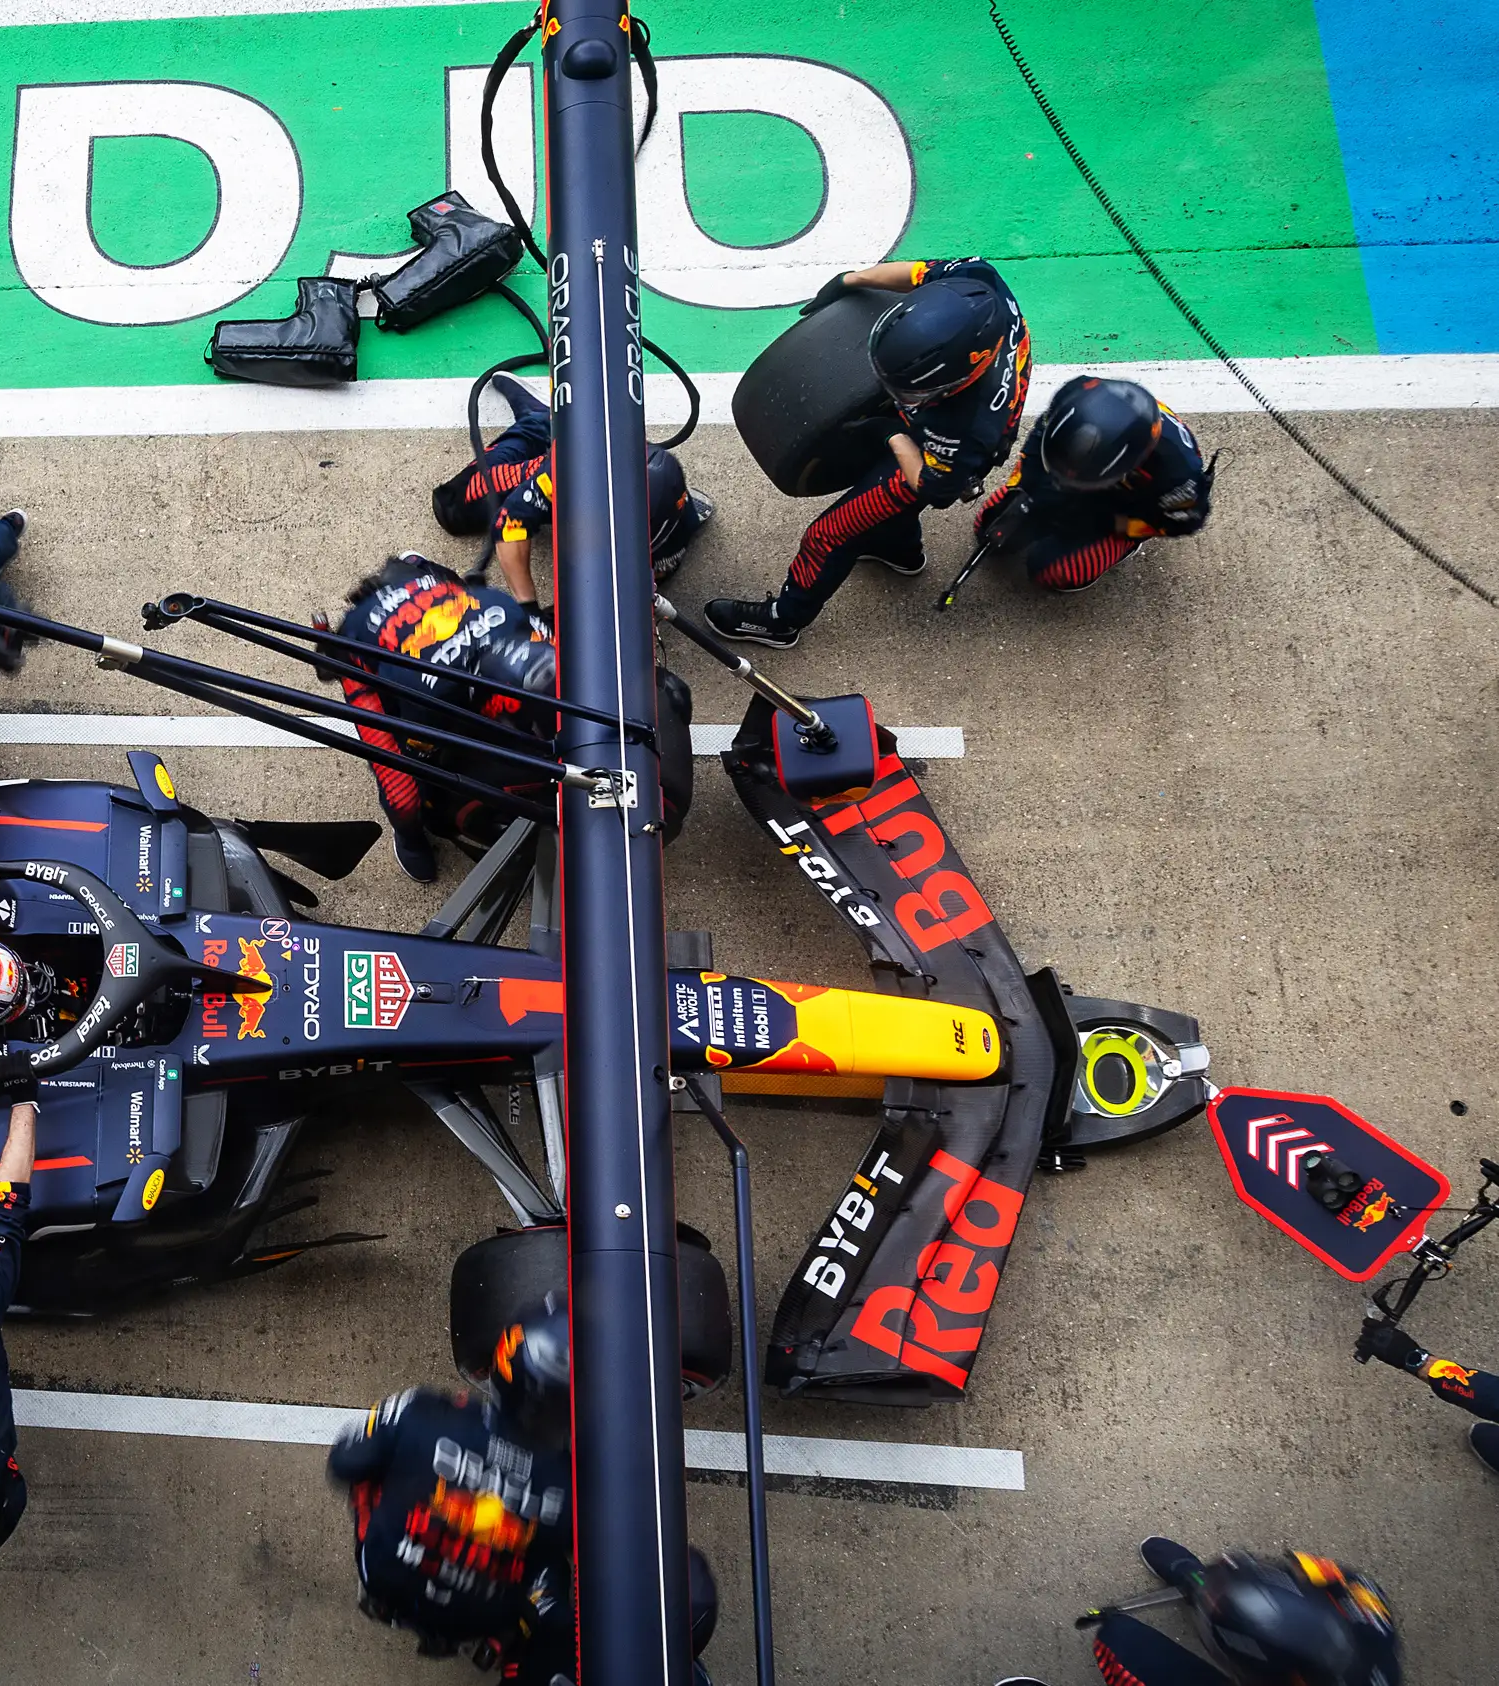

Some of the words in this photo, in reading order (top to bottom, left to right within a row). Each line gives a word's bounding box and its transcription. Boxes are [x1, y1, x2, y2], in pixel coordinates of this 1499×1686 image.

[552, 253, 572, 412] ORACLE
[623, 245, 643, 405] ORACLE
[139, 825, 151, 876] Walmart
[25, 862, 69, 885] BYBIT
[164, 878, 172, 894] Cash
[767, 819, 881, 927] BYBIT
[79, 886, 116, 931] ORACLE
[115, 945, 125, 976] HEUER
[126, 945, 137, 975] TAG
[203, 940, 227, 968] Re
[303, 937, 320, 1041] ORACLE
[351, 958, 370, 1021] TAG
[380, 957, 401, 1024] HEUER
[677, 983, 687, 1021] ARCTIC
[687, 987, 698, 1018] WOLF
[76, 995, 112, 1043] telcel
[202, 993, 227, 1038] Bull
[707, 985, 725, 1046] PIRELLI
[731, 988, 746, 1048] infinitum
[753, 1005, 770, 1049] Mobil
[4, 1078, 28, 1088] arco
[111, 1061, 145, 1070] Therabody
[158, 1059, 166, 1077] Cash
[278, 1059, 392, 1080] BYBIT
[130, 1091, 143, 1146] Walmart
[148, 1175, 161, 1200] RAUCH
[1356, 1177, 1385, 1205] Red
[803, 1151, 904, 1299] BYBIT
[1336, 1200, 1364, 1226] Bull
[850, 1149, 1025, 1390] Red
